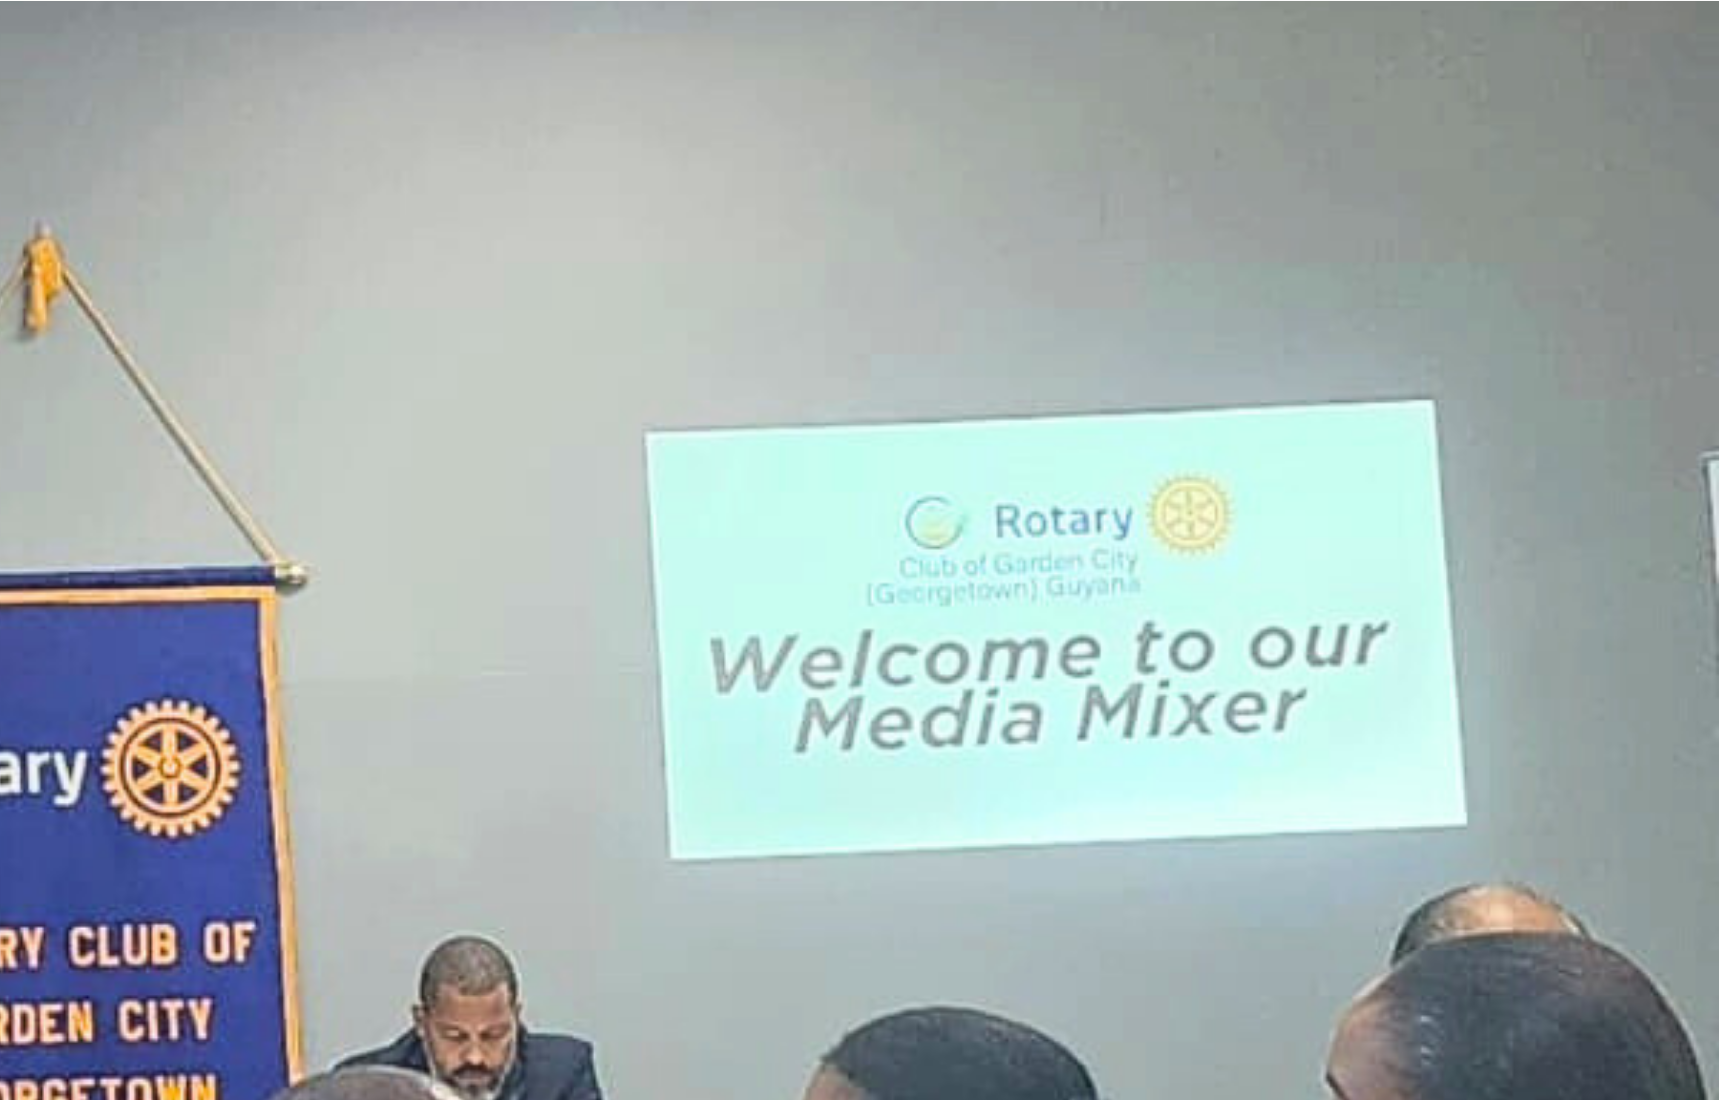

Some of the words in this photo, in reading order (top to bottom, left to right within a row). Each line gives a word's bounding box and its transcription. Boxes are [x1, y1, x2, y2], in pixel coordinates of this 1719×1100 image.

[995, 501, 1134, 542] Rotary
[898, 556, 959, 580] Club
[963, 554, 986, 577] of
[993, 550, 1085, 576] Garden
[1091, 547, 1139, 576] City
[866, 578, 1038, 609] (Georgetown)
[1045, 573, 1142, 599] Guyana
[709, 629, 1102, 694] Welcome
[1134, 620, 1215, 675] to
[1249, 620, 1390, 669] our
[794, 688, 1044, 754] Media
[1076, 679, 1308, 741] Mixer
[68, 922, 178, 967] CLUB
[204, 920, 257, 963] OF
[118, 997, 213, 1042] CITY
